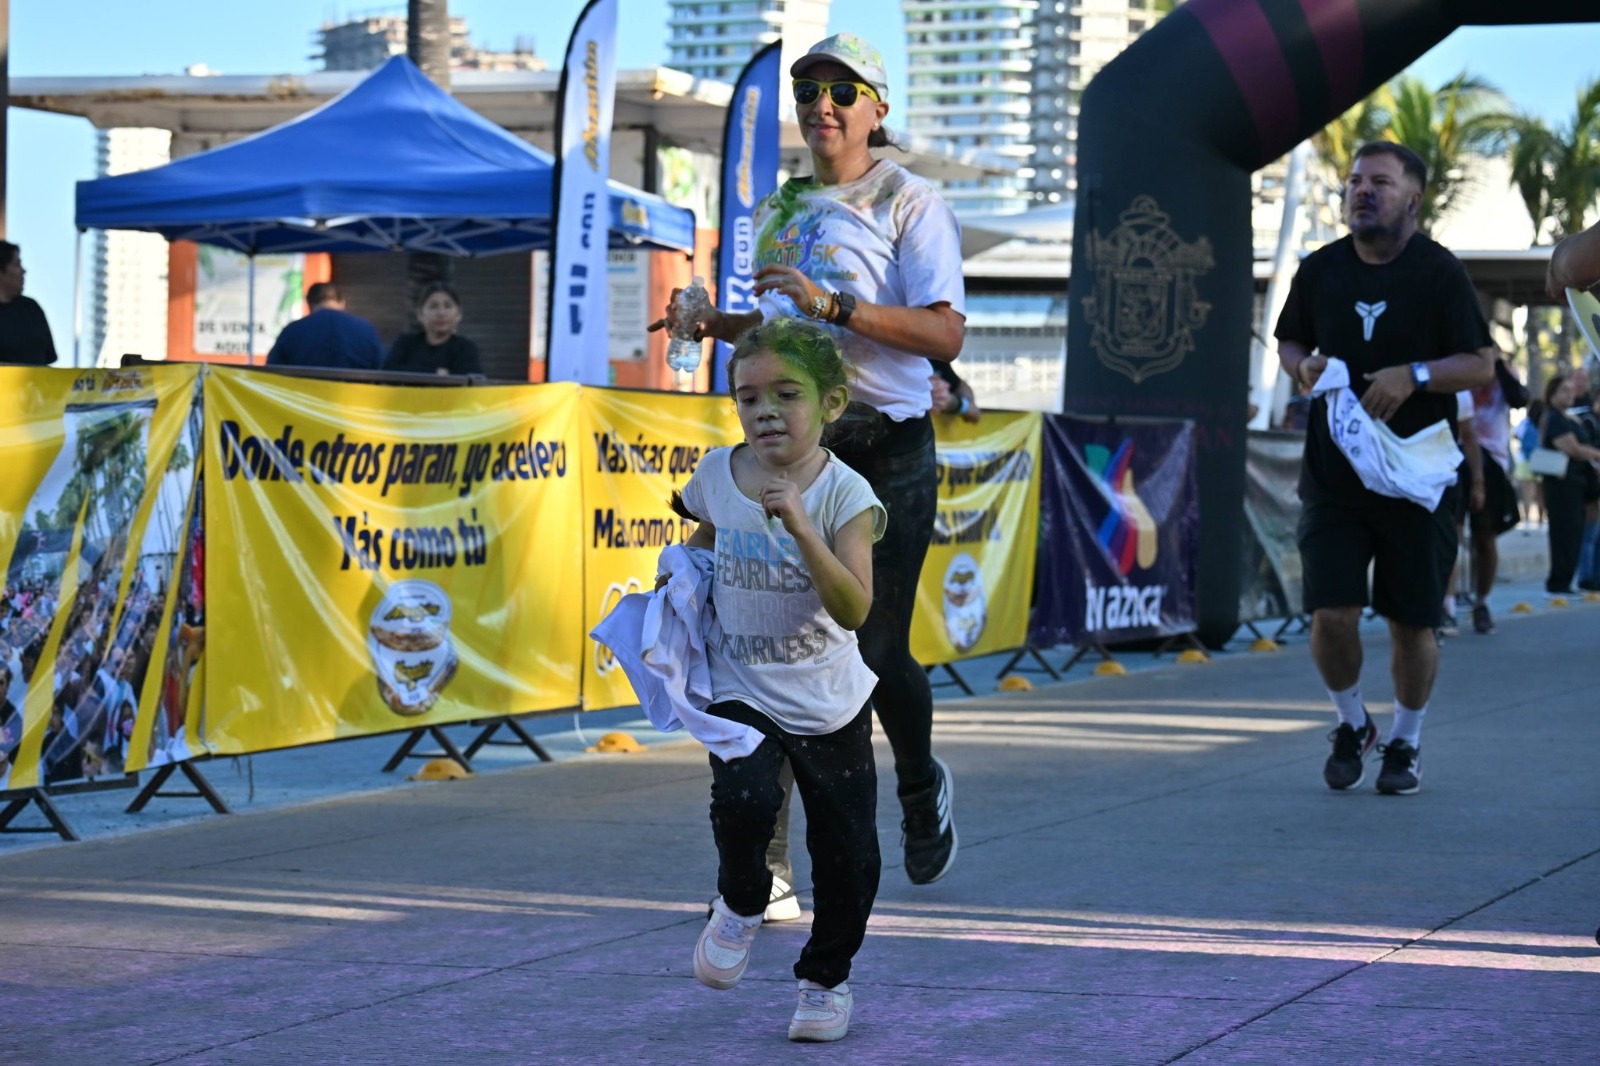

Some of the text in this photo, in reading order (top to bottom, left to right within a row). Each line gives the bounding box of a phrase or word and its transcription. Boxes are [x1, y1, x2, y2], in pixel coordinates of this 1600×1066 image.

[811, 243, 840, 267] 5K
[221, 322, 265, 334] VENA
[220, 420, 304, 484] Donde
[310, 433, 386, 484] otros
[381, 443, 458, 497] paran,
[458, 443, 492, 498] yo
[669, 446, 699, 482] que
[390, 527, 457, 570] como
[458, 508, 487, 566] tú
[630, 518, 674, 548] como
[717, 527, 802, 567] FEARLES
[717, 551, 817, 593] FEARLES
